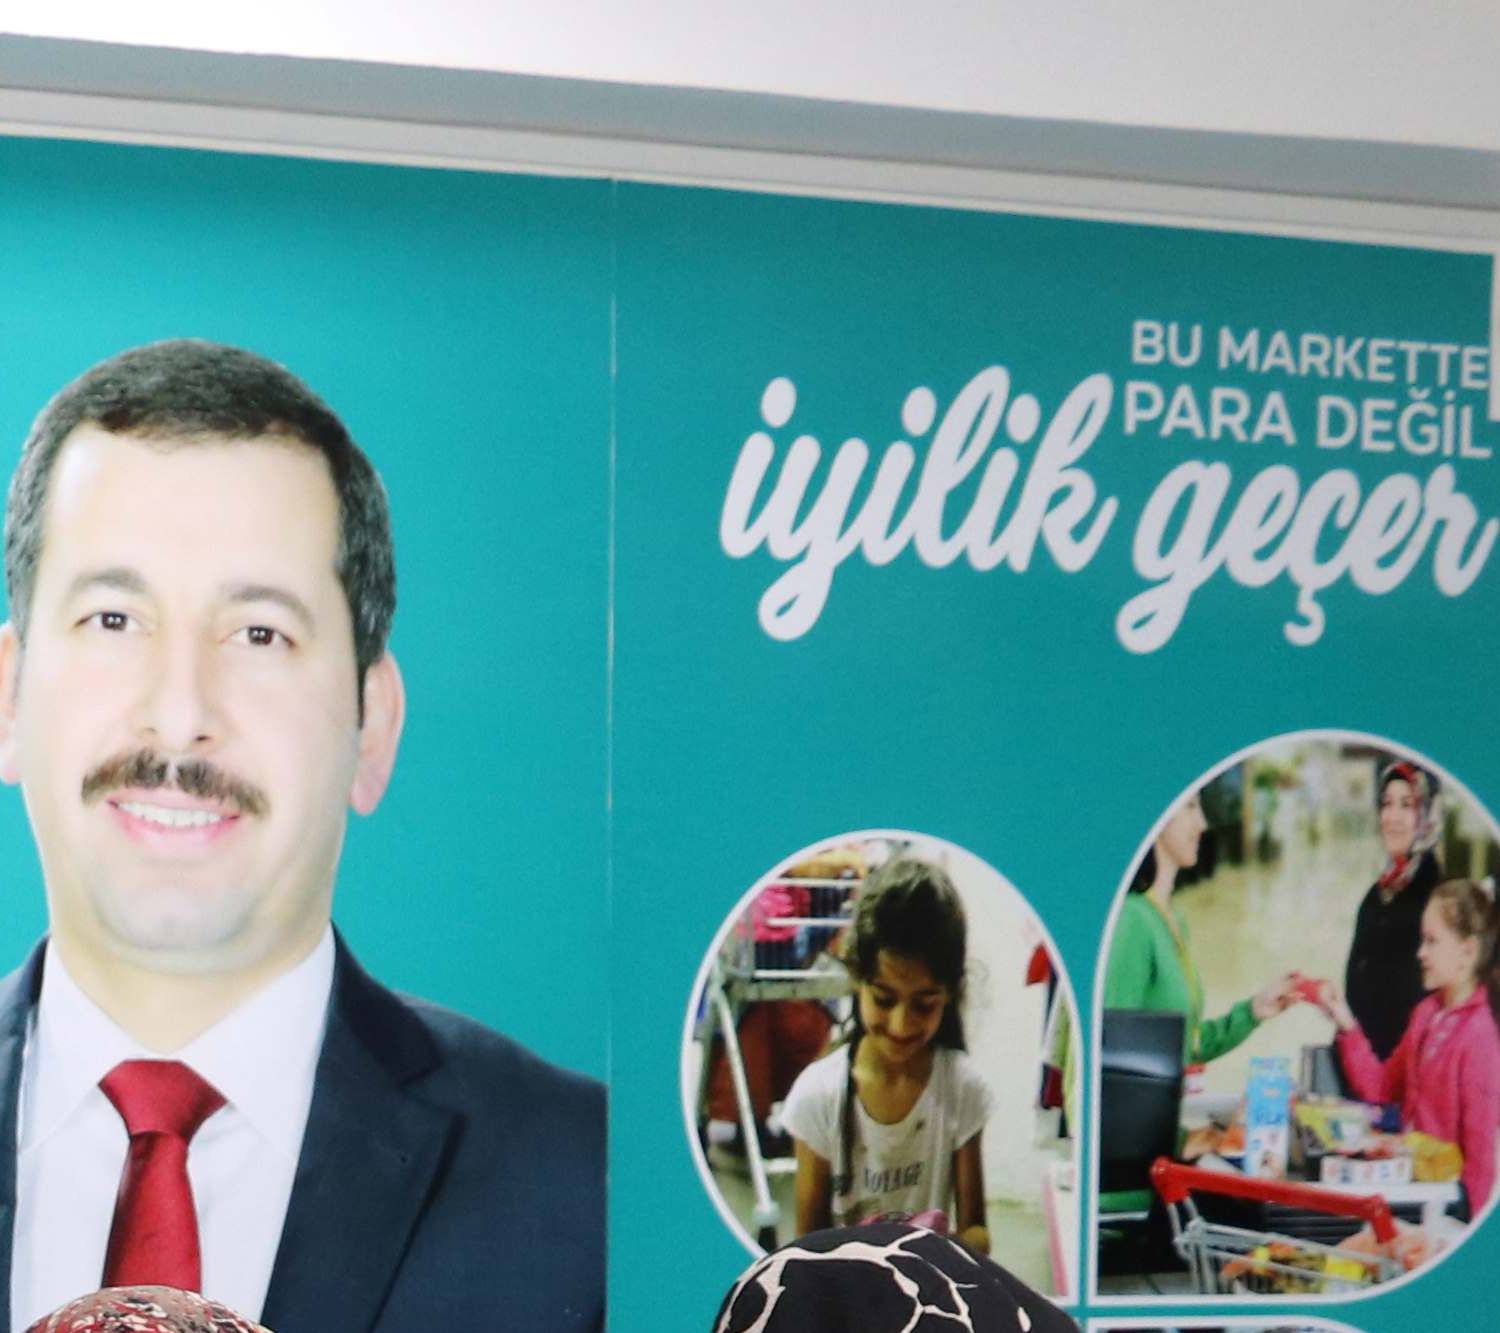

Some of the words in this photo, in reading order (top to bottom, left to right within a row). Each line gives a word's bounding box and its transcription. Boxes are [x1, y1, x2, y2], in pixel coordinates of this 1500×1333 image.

[1131, 320, 1200, 366] BU
[1217, 325, 1489, 389] MARKETTE
[1124, 382, 1296, 445] PARA
[1316, 389, 1491, 459] DEĞİL
[720, 365, 1118, 641] iyilik
[1116, 460, 1500, 654] geçer
